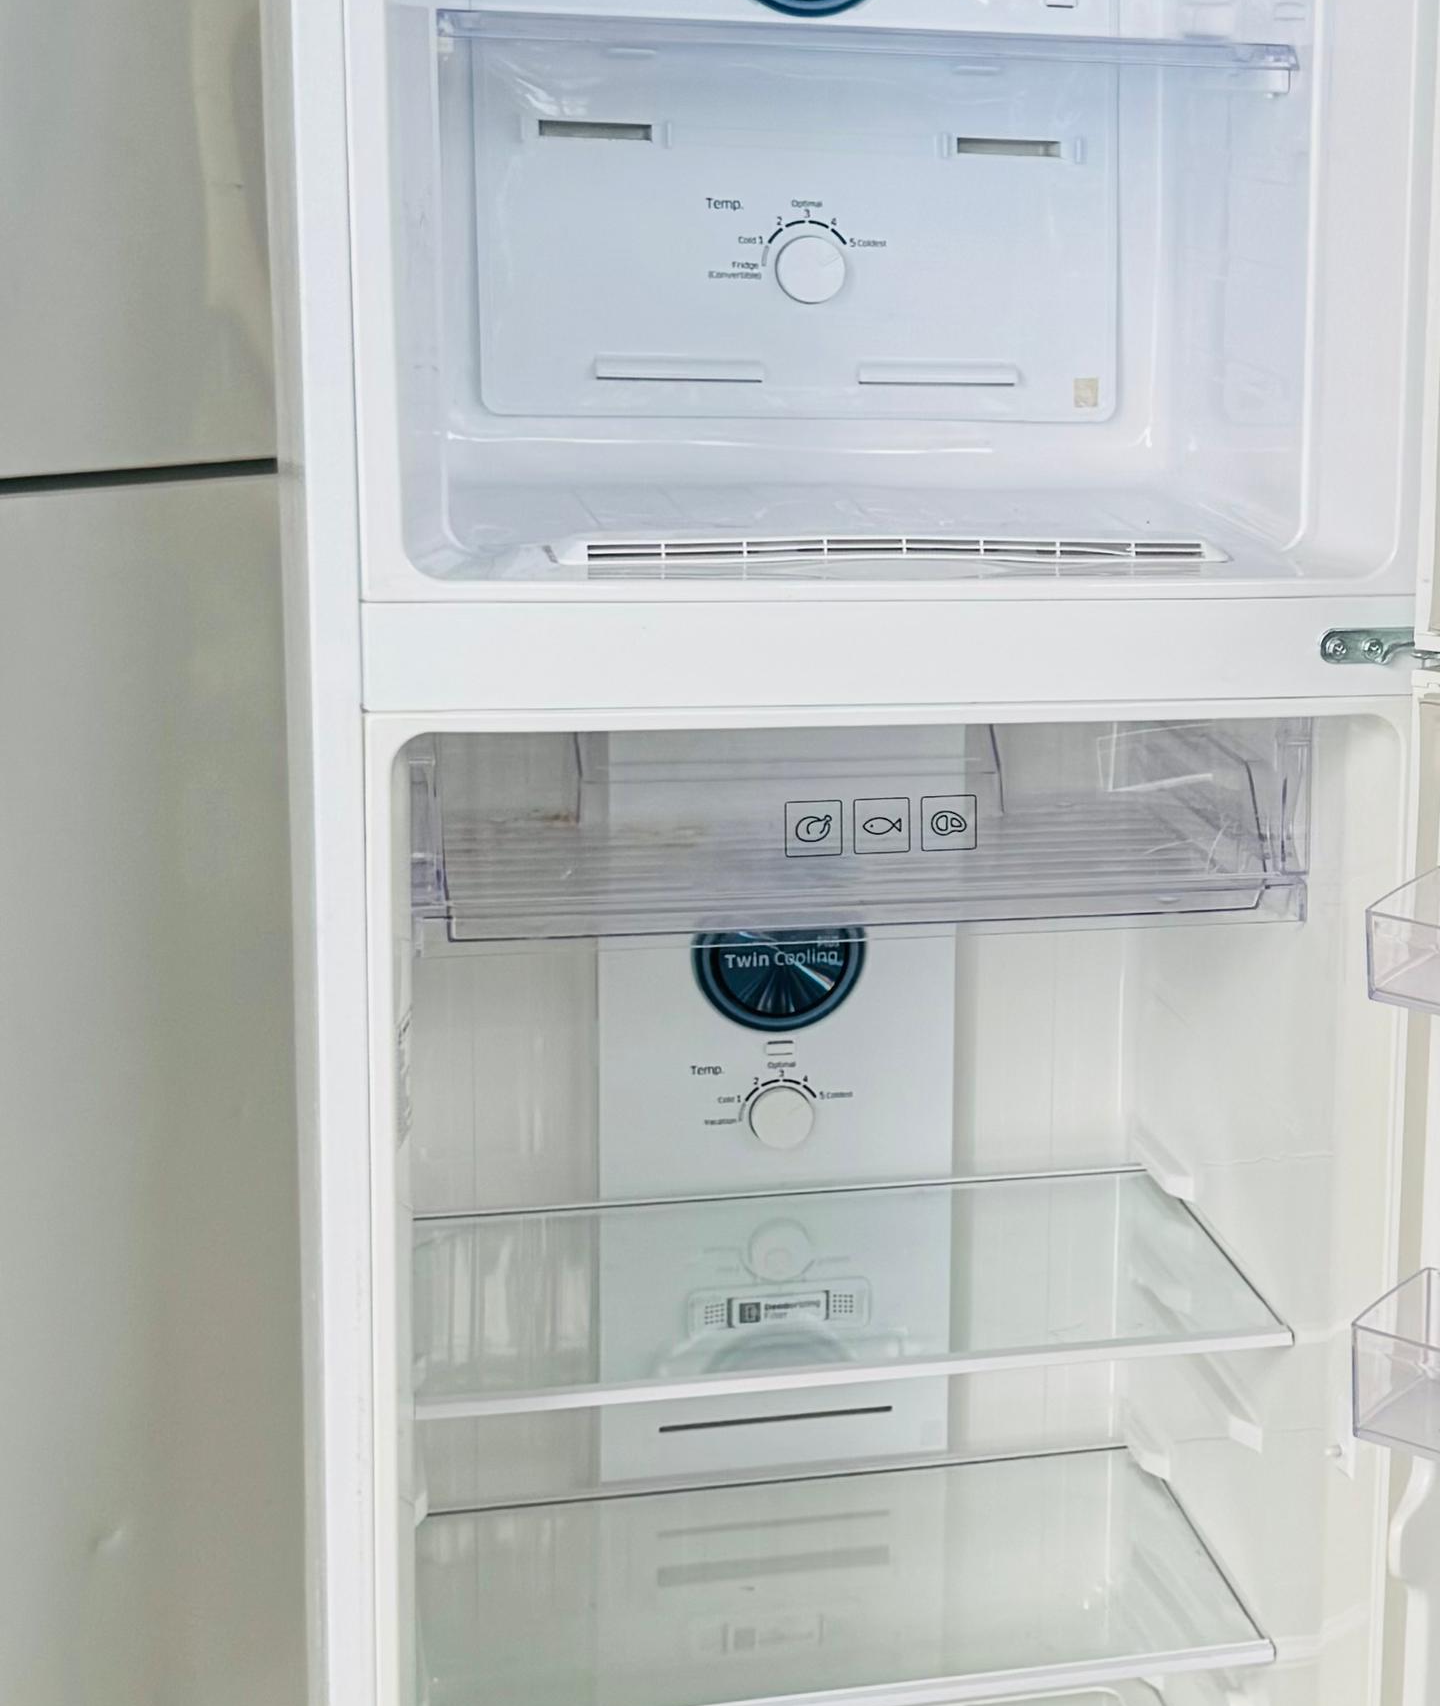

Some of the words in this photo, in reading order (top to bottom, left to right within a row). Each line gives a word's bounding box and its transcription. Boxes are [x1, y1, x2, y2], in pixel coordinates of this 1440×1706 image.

[706, 197, 744, 211] Temp.
[791, 199, 823, 208] Optimal
[804, 209, 811, 218] 3
[776, 216, 783, 225] 2
[830, 217, 837, 226] 4
[738, 236, 757, 244] Cold
[857, 239, 887, 247] Coldest
[732, 261, 759, 270] Fridge
[708, 271, 762, 280] (Convertible)
[724, 952, 769, 968] Twin
[774, 948, 838, 966] Cooling
